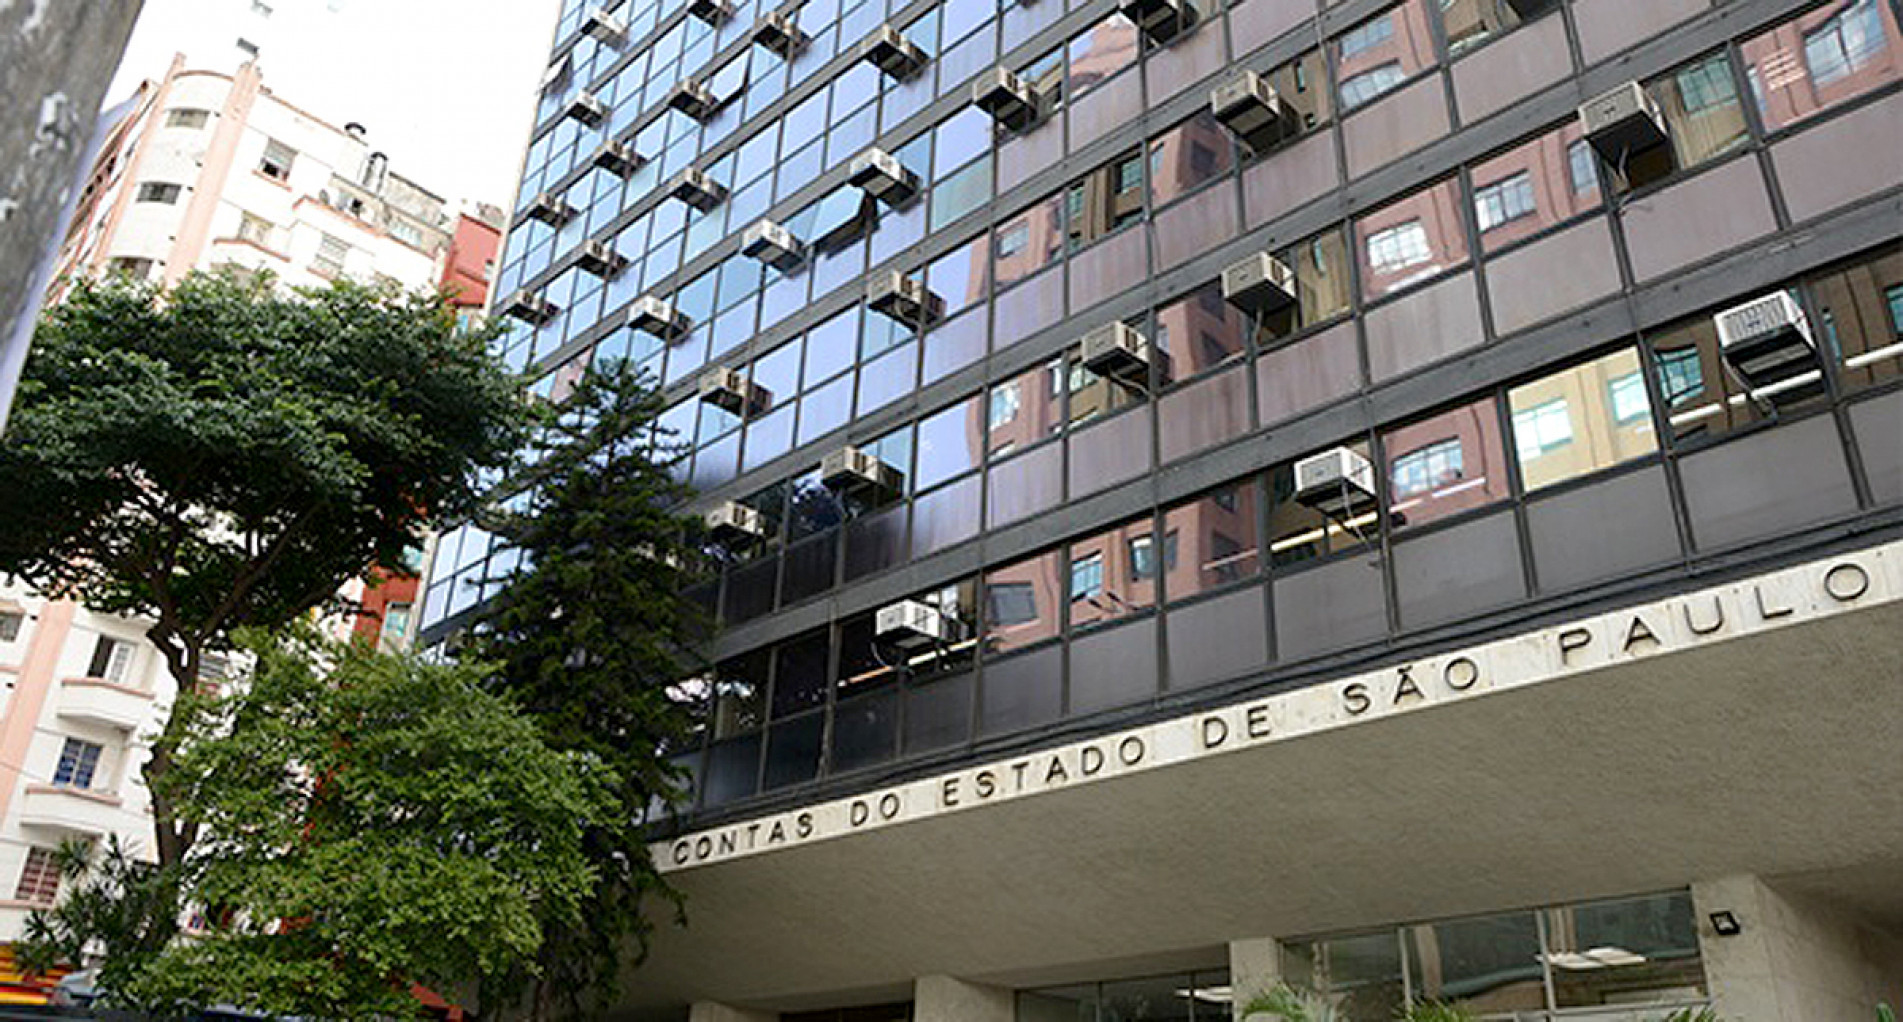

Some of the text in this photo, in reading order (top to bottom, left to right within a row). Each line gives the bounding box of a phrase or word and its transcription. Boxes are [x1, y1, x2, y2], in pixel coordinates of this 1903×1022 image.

[672, 562, 1870, 866] CONTAS DO ESTADO DE SÃO PAULO
